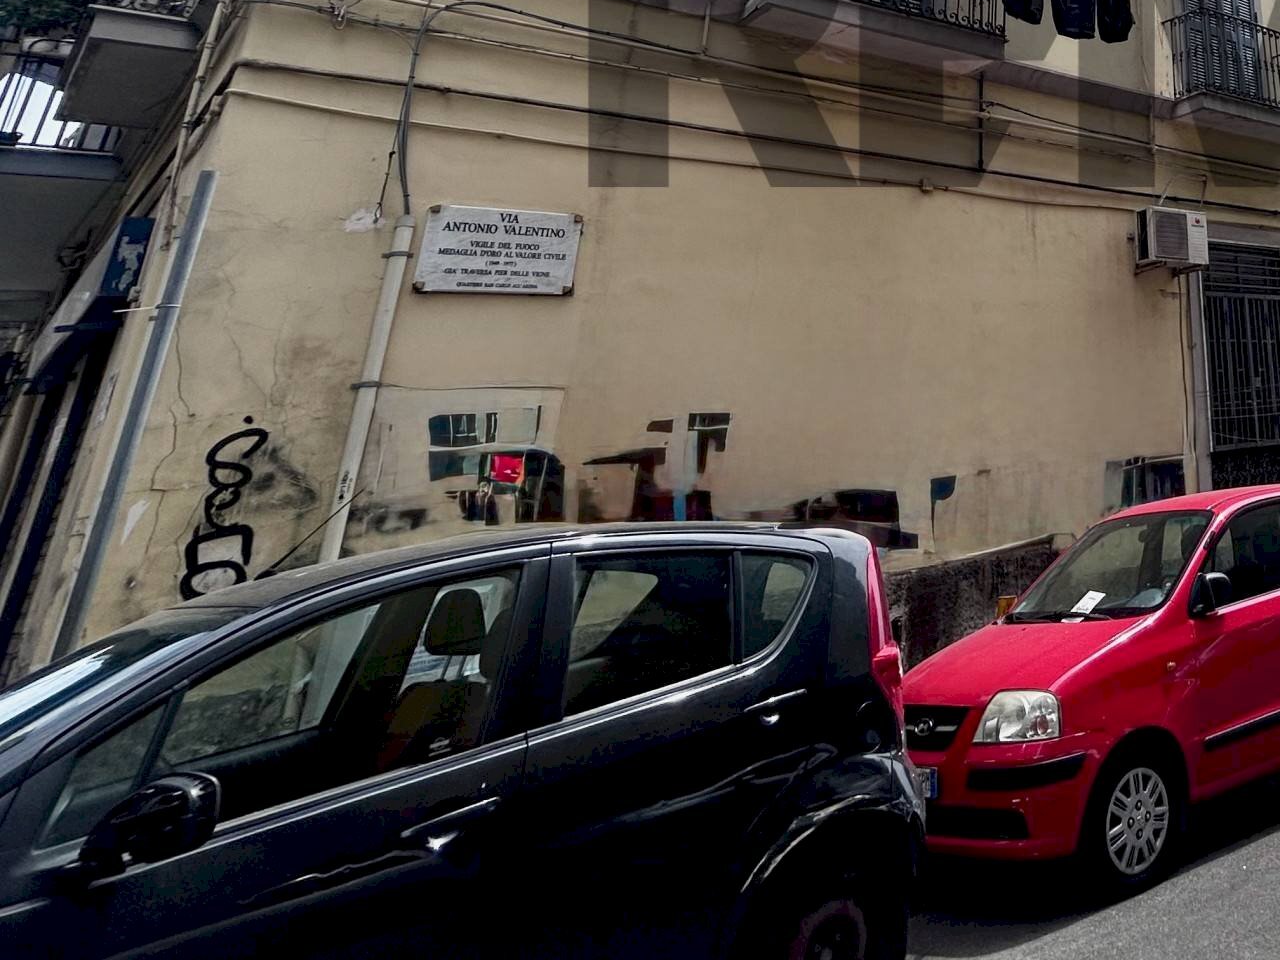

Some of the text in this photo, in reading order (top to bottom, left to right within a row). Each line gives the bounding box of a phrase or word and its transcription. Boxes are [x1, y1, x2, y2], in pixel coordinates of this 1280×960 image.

[500, 213, 519, 224] VIA
[442, 221, 565, 238] ANTONIO VALENTINO
[470, 240, 540, 250] VIGILE DEL FUOCO
[438, 247, 477, 256] MEDAGLIA
[504, 250, 514, 258] AL
[515, 251, 542, 259] VALORE
